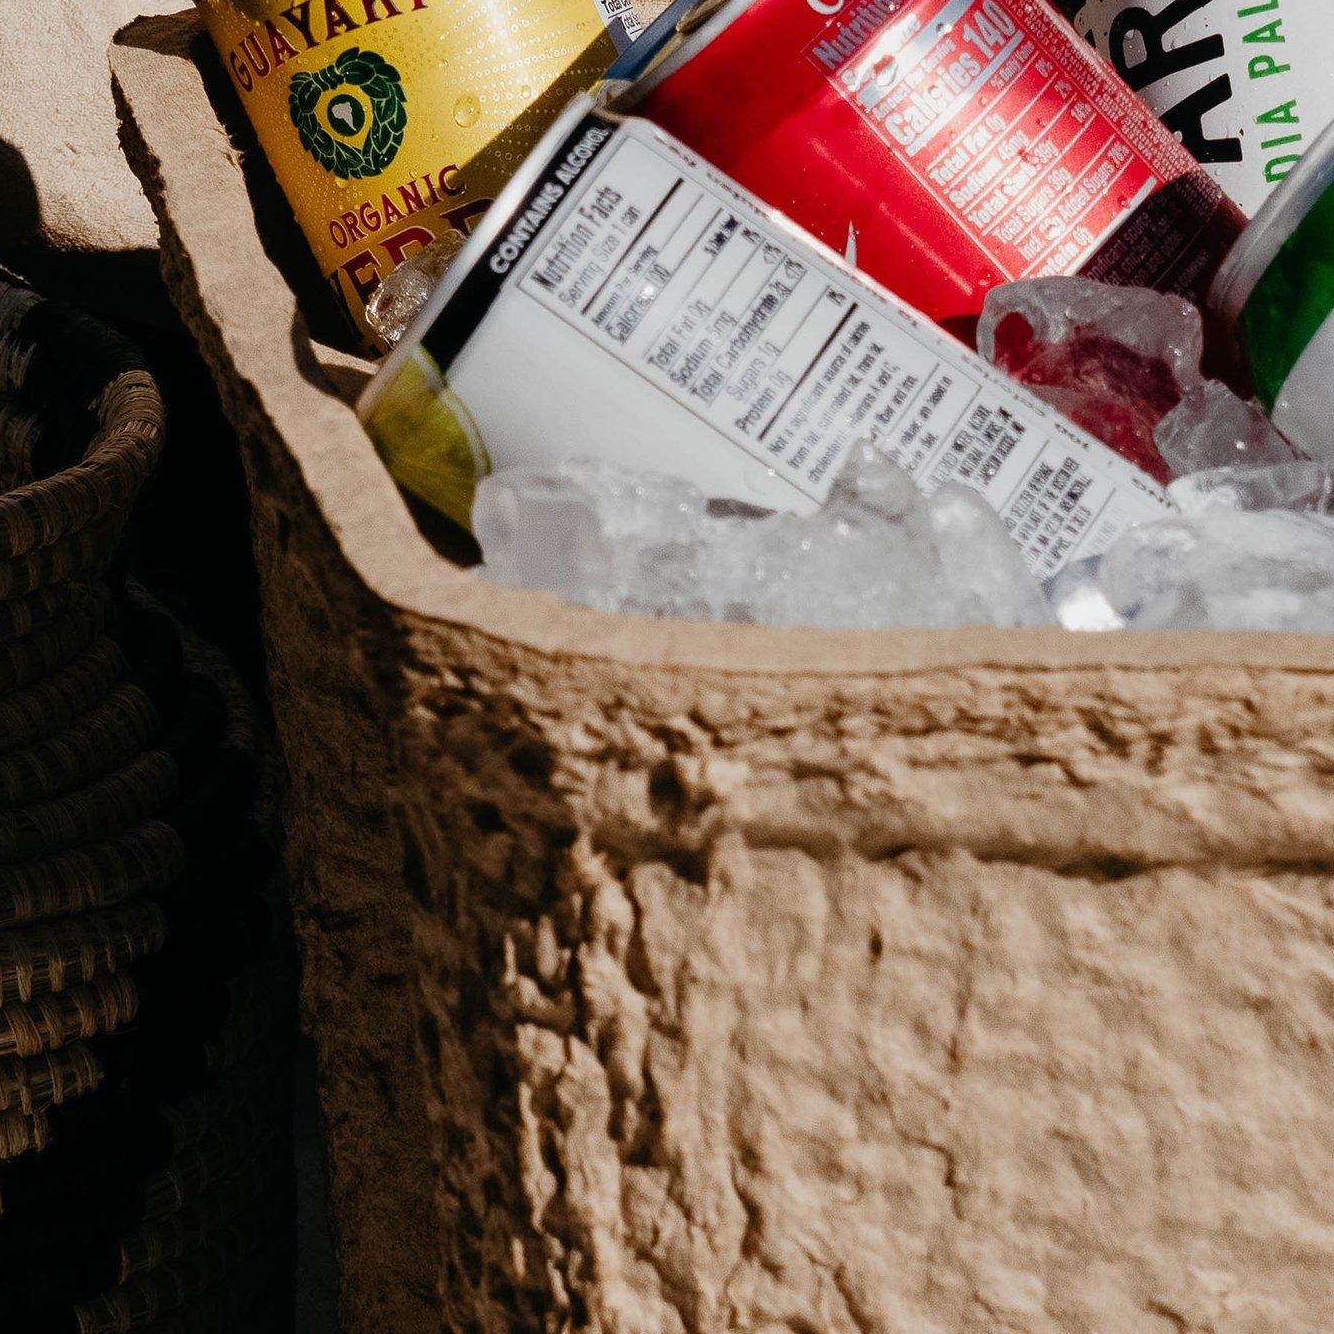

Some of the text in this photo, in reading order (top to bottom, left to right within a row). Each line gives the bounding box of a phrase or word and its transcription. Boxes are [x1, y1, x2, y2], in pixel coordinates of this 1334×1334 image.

[881, 45, 983, 148] Calories
[1254, 99, 1304, 184] DIA
[328, 164, 467, 249] ORGANIC
[489, 126, 610, 274] CONTAINS ALCOHOL
[525, 179, 625, 294] Nutrition Facts
[555, 257, 604, 310] Serving
[604, 280, 660, 343] Calorie
[645, 334, 682, 373] Total
[667, 334, 716, 389] Sodium
[688, 364, 726, 405] Total
[711, 289, 784, 373] Carbohydrate
[724, 353, 769, 403] Sugars
[733, 384, 778, 435] Protein
